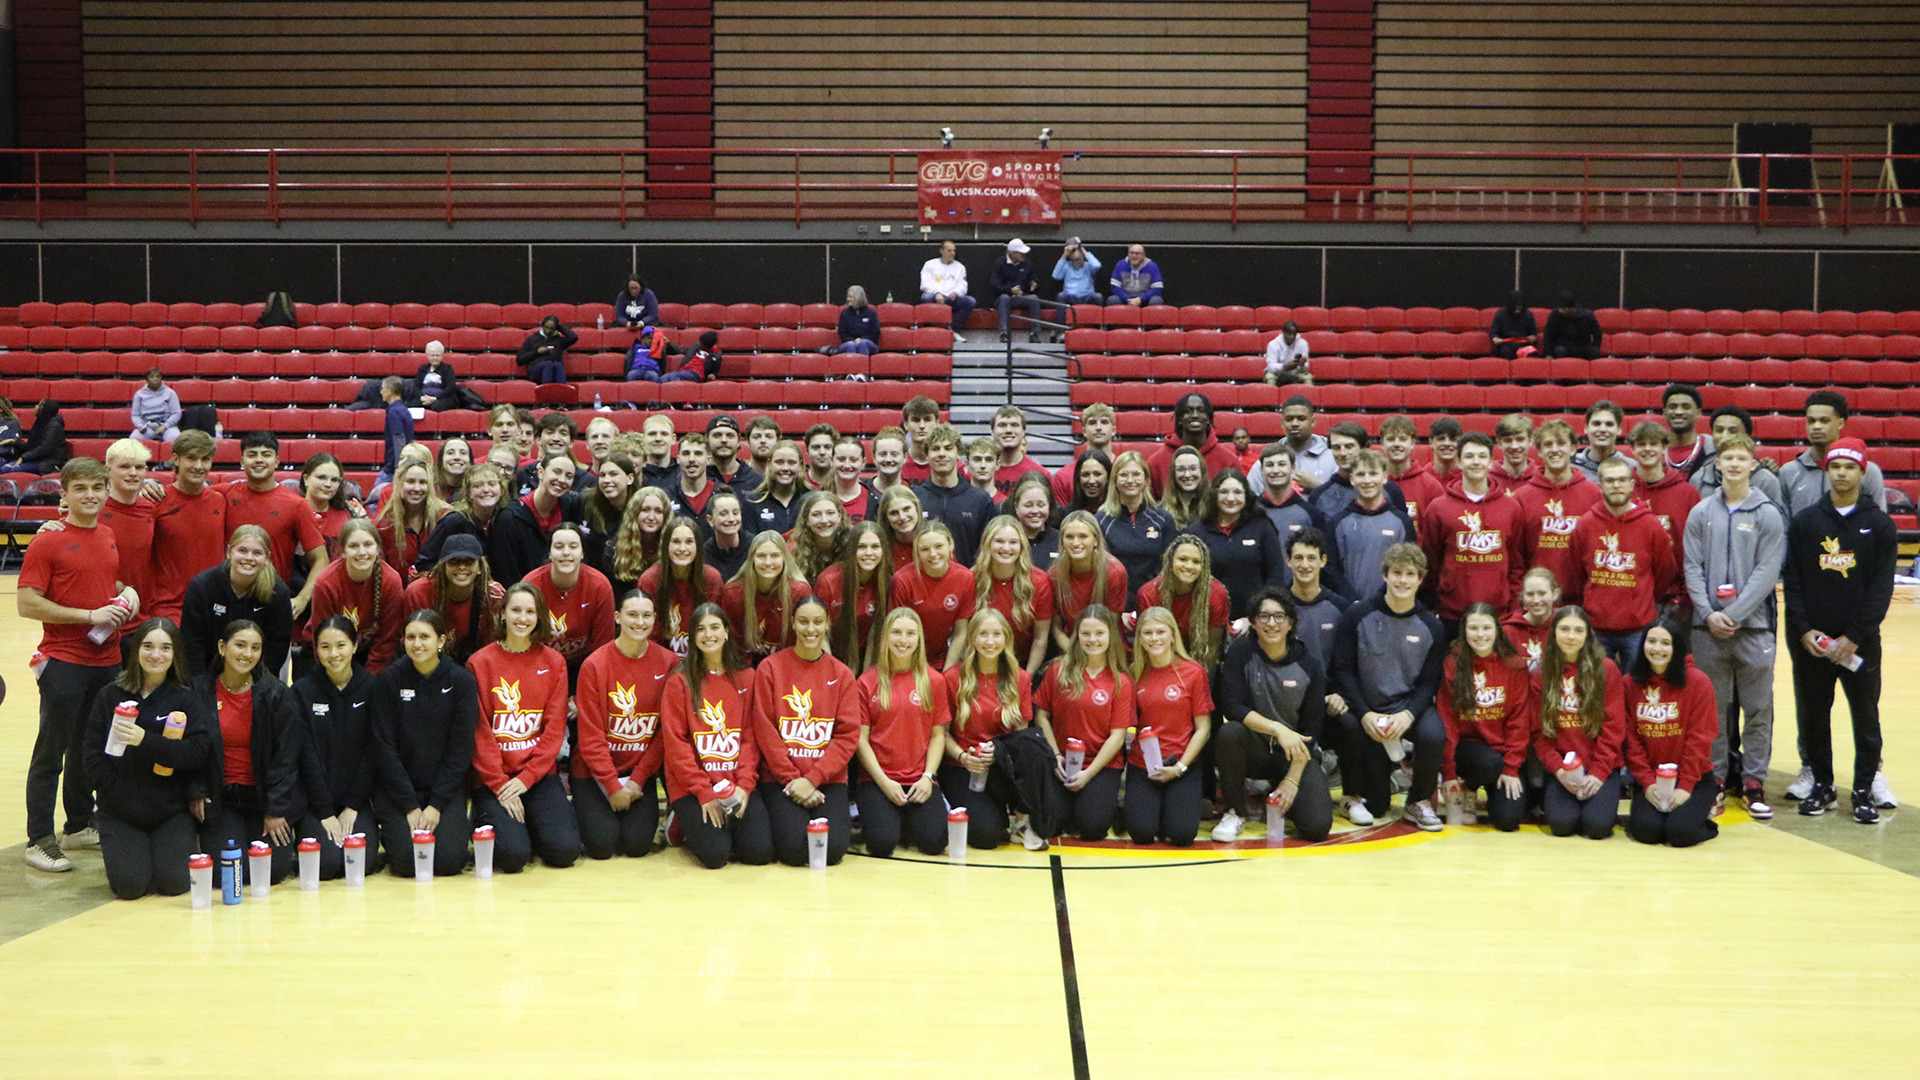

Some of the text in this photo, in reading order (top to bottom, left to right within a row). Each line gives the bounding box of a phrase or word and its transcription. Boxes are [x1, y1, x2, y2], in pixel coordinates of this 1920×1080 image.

[921, 160, 1061, 182] GLVC SPORTS
[1005, 172, 1061, 181] NETWORK
[941, 187, 1038, 197] GLVCSN.COM/UMSL
[1458, 533, 1501, 552] UMSL
[1486, 553, 1503, 562] FIELD
[1476, 688, 1506, 707] MSL
[1636, 704, 1678, 722] UMSL
[608, 715, 657, 740] UMSL
[697, 732, 741, 758] UMS
